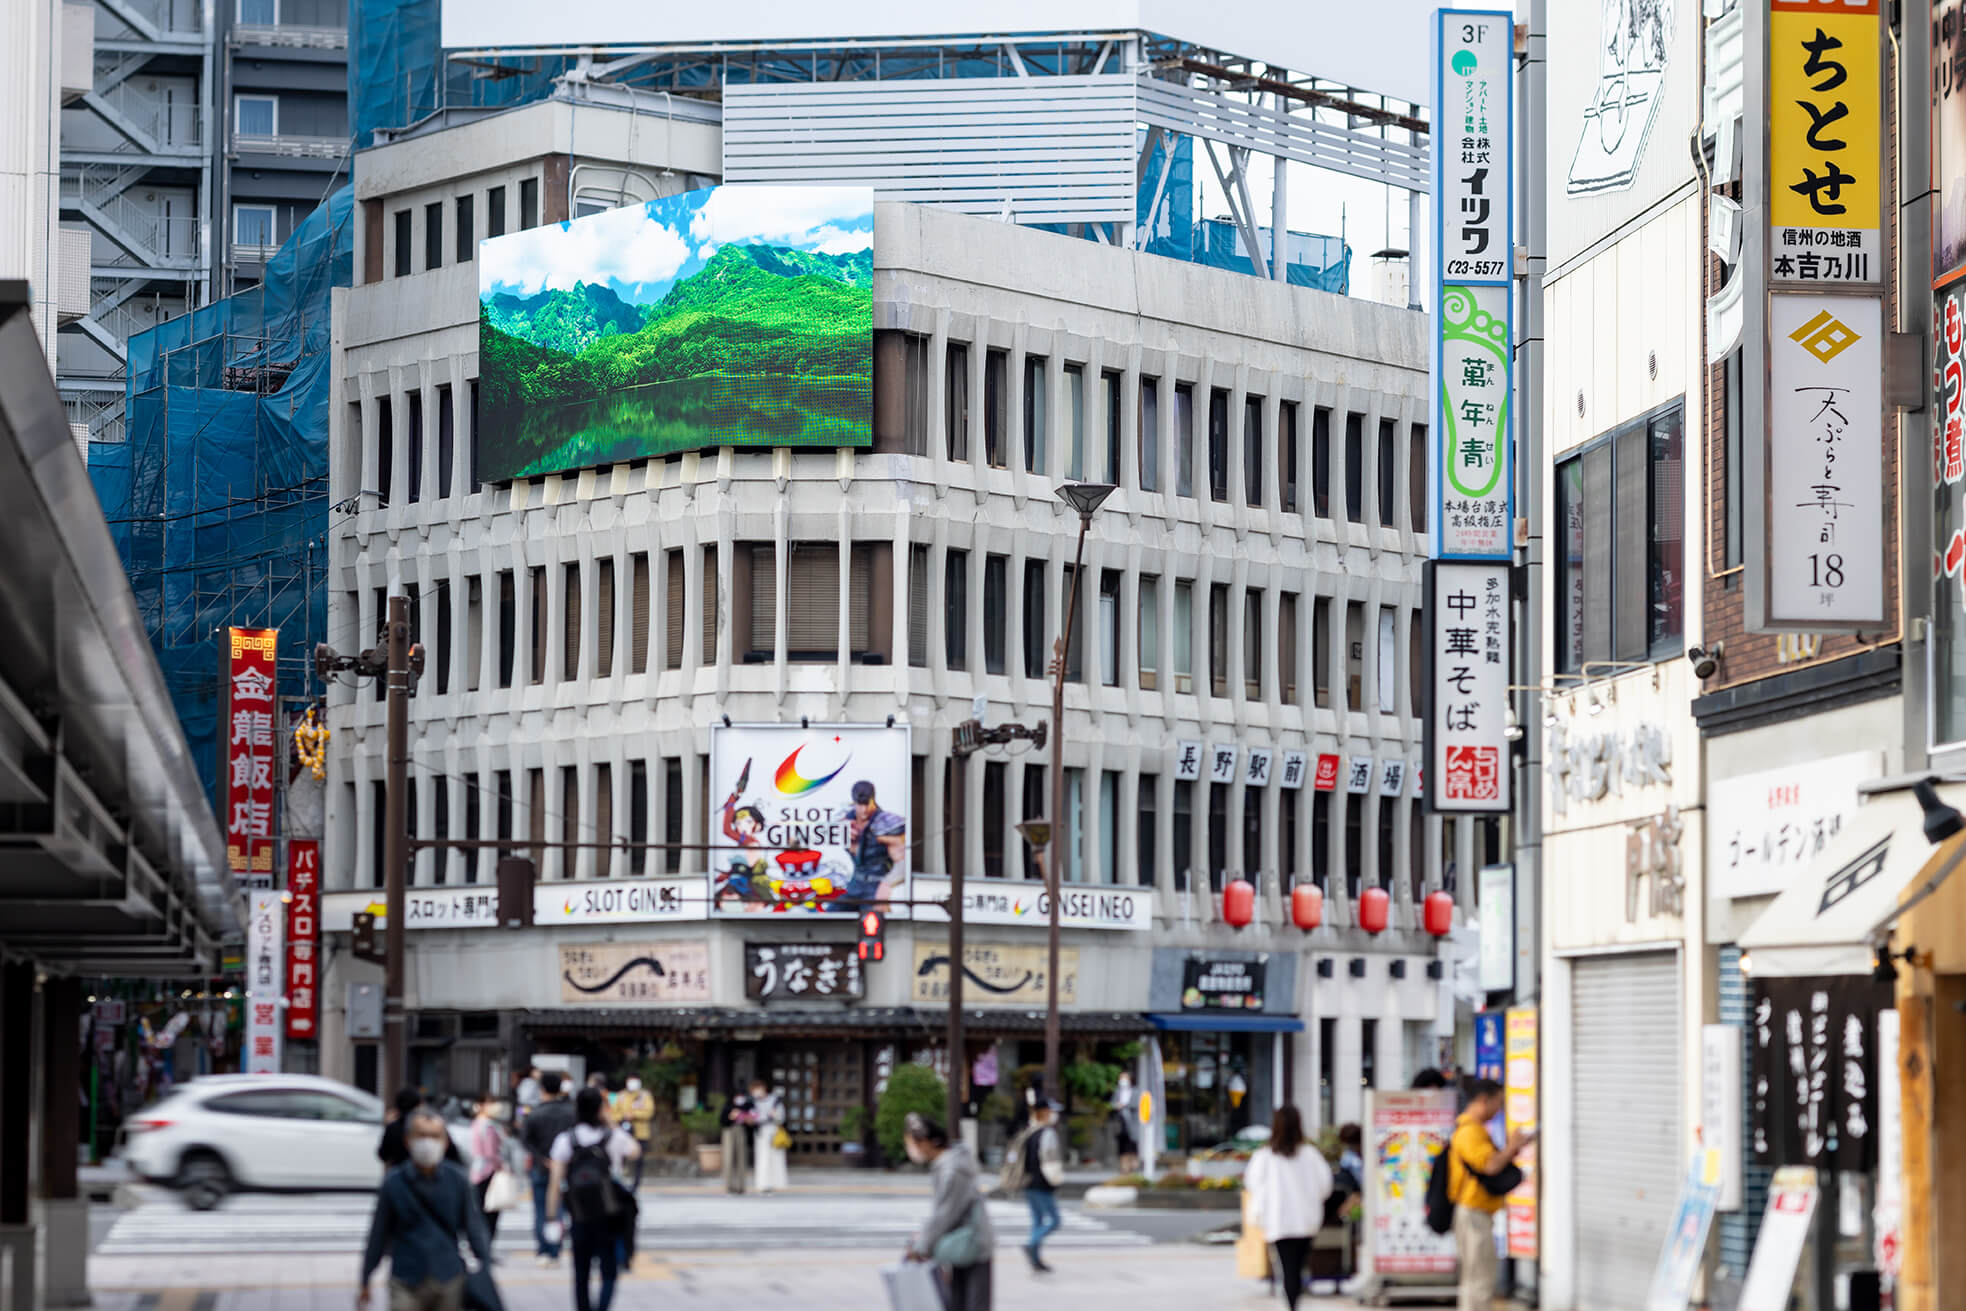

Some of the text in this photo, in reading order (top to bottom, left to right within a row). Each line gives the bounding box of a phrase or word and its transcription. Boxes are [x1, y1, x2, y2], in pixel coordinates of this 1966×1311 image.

[1462, 24, 1489, 44] 3F
[1789, 27, 1857, 215] ちとせ
[1461, 168, 1490, 255] イツワ
[1782, 228, 1862, 248] 信州の地酒
[1774, 251, 1868, 281] 本吉乃川
[1460, 357, 1487, 468] 萬年青
[1807, 553, 1844, 588] 18
[1445, 588, 1481, 731] 中華そば
[229, 666, 274, 836] 金龍飯店
[1179, 746, 1302, 790] 長野駅前
[1350, 763, 1402, 796] 酒場
[780, 808, 836, 822] SLOT
[767, 825, 848, 847] GINSEI
[586, 889, 623, 913] SLOT
[1038, 892, 1134, 919] GNSEI NEO
[754, 948, 844, 996] うなぎ
[255, 1003, 274, 1074] 営業
